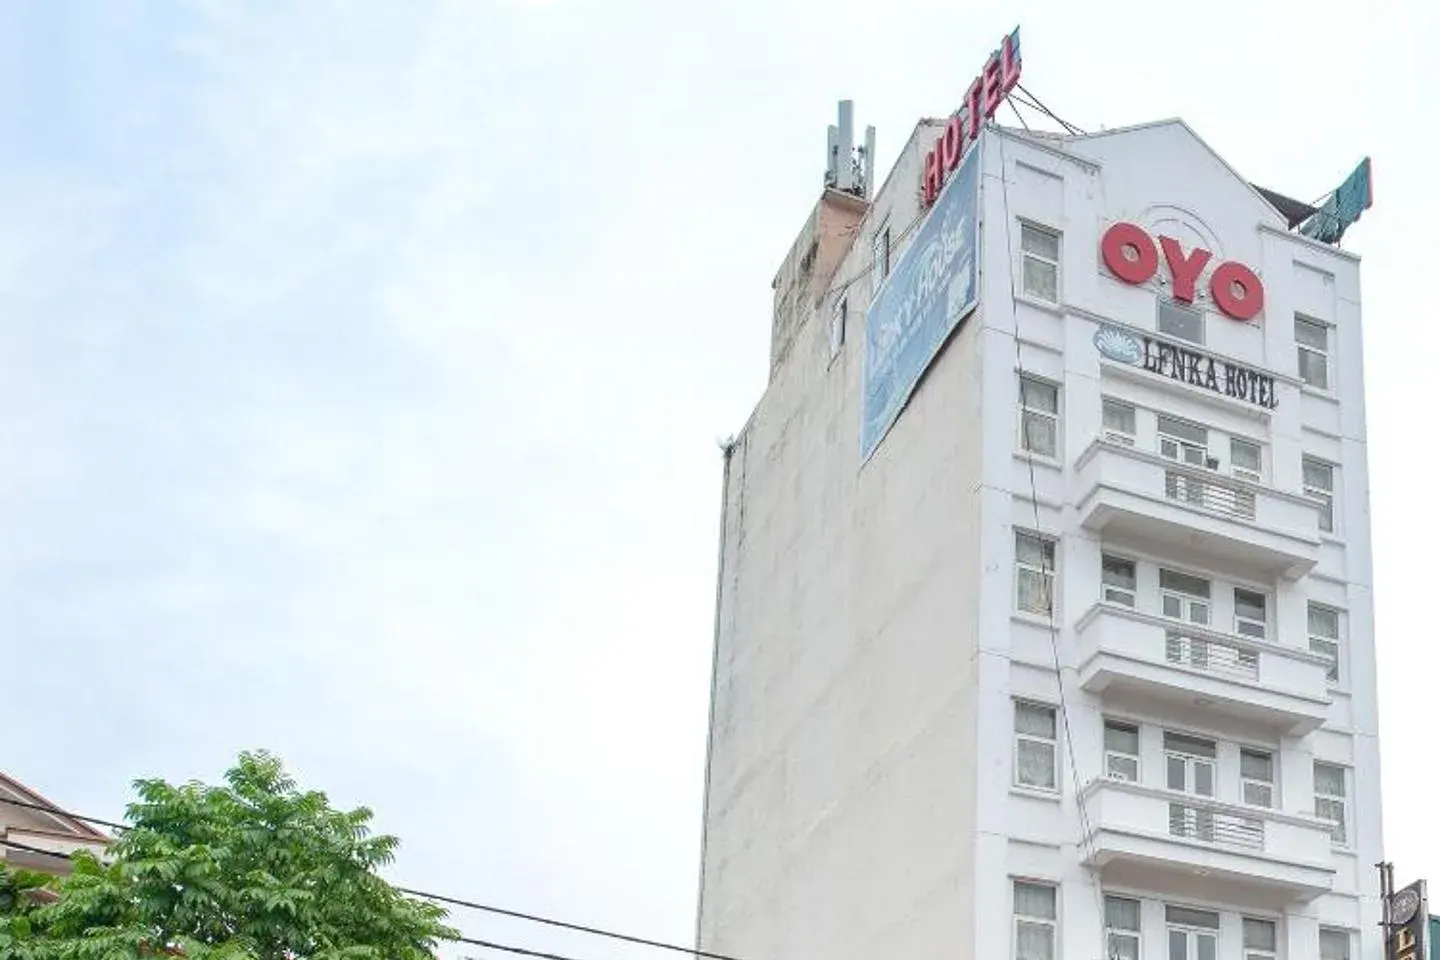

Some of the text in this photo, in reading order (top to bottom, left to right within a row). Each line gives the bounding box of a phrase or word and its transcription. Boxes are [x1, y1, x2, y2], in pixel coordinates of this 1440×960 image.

[923, 34, 1021, 208] HOTEL
[1101, 221, 1264, 321] OYO
[1224, 363, 1279, 410] HOTEL
